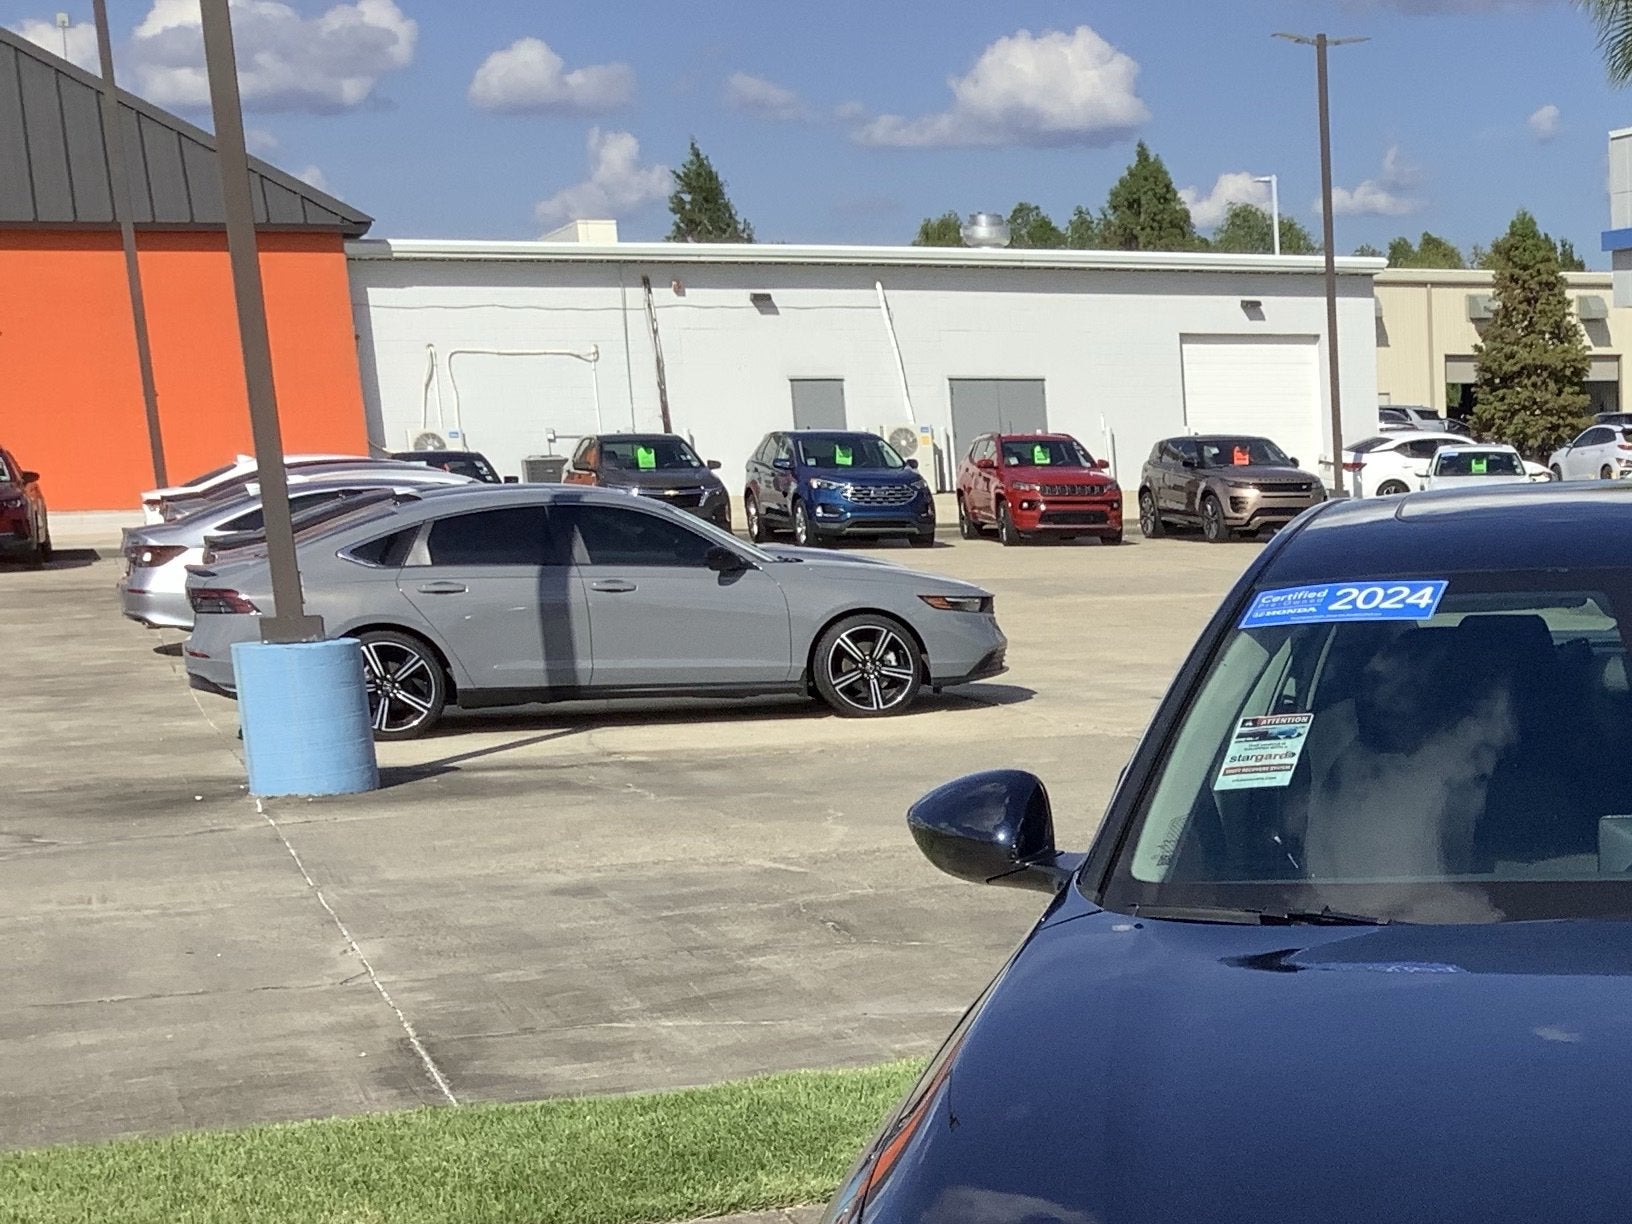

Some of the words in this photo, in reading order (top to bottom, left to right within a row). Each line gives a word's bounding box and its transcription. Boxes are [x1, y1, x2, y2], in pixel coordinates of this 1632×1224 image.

[1260, 588, 1329, 604] Certified
[1327, 586, 1435, 611] 2024
[1264, 606, 1317, 617] HONDA
[1261, 716, 1309, 726] ATTENTION
